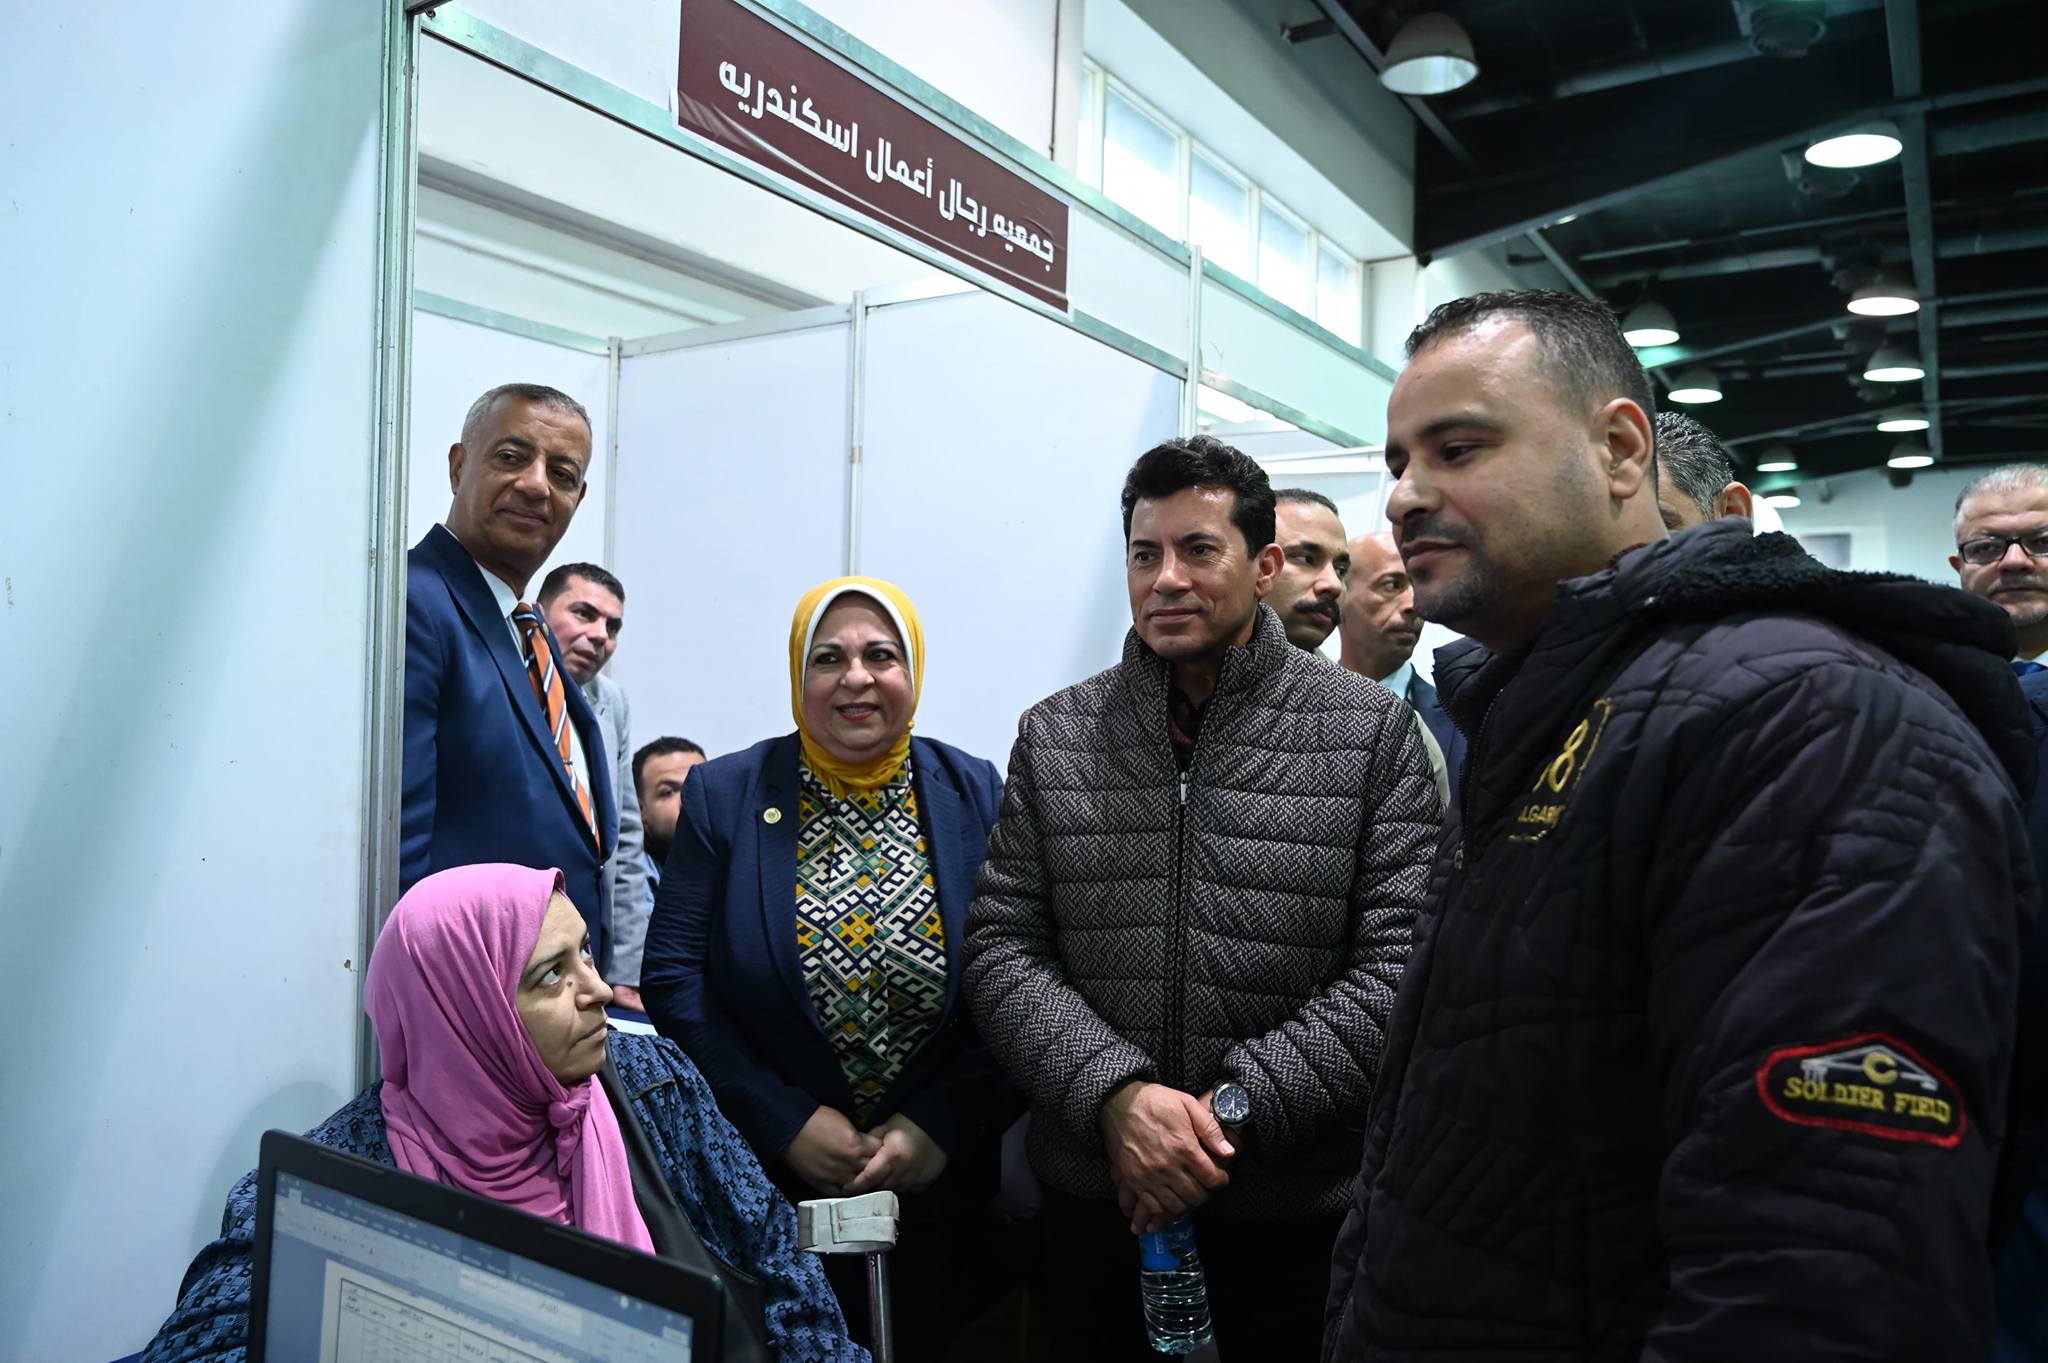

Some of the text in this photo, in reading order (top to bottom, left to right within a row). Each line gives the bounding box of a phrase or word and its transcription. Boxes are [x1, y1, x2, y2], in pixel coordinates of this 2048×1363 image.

[718, 60, 1054, 272] جمعيه رجال أعمال اسكندريه
[1863, 1052, 1898, 1084] C
[1784, 1077, 1950, 1124] SOLDIER FIELD
